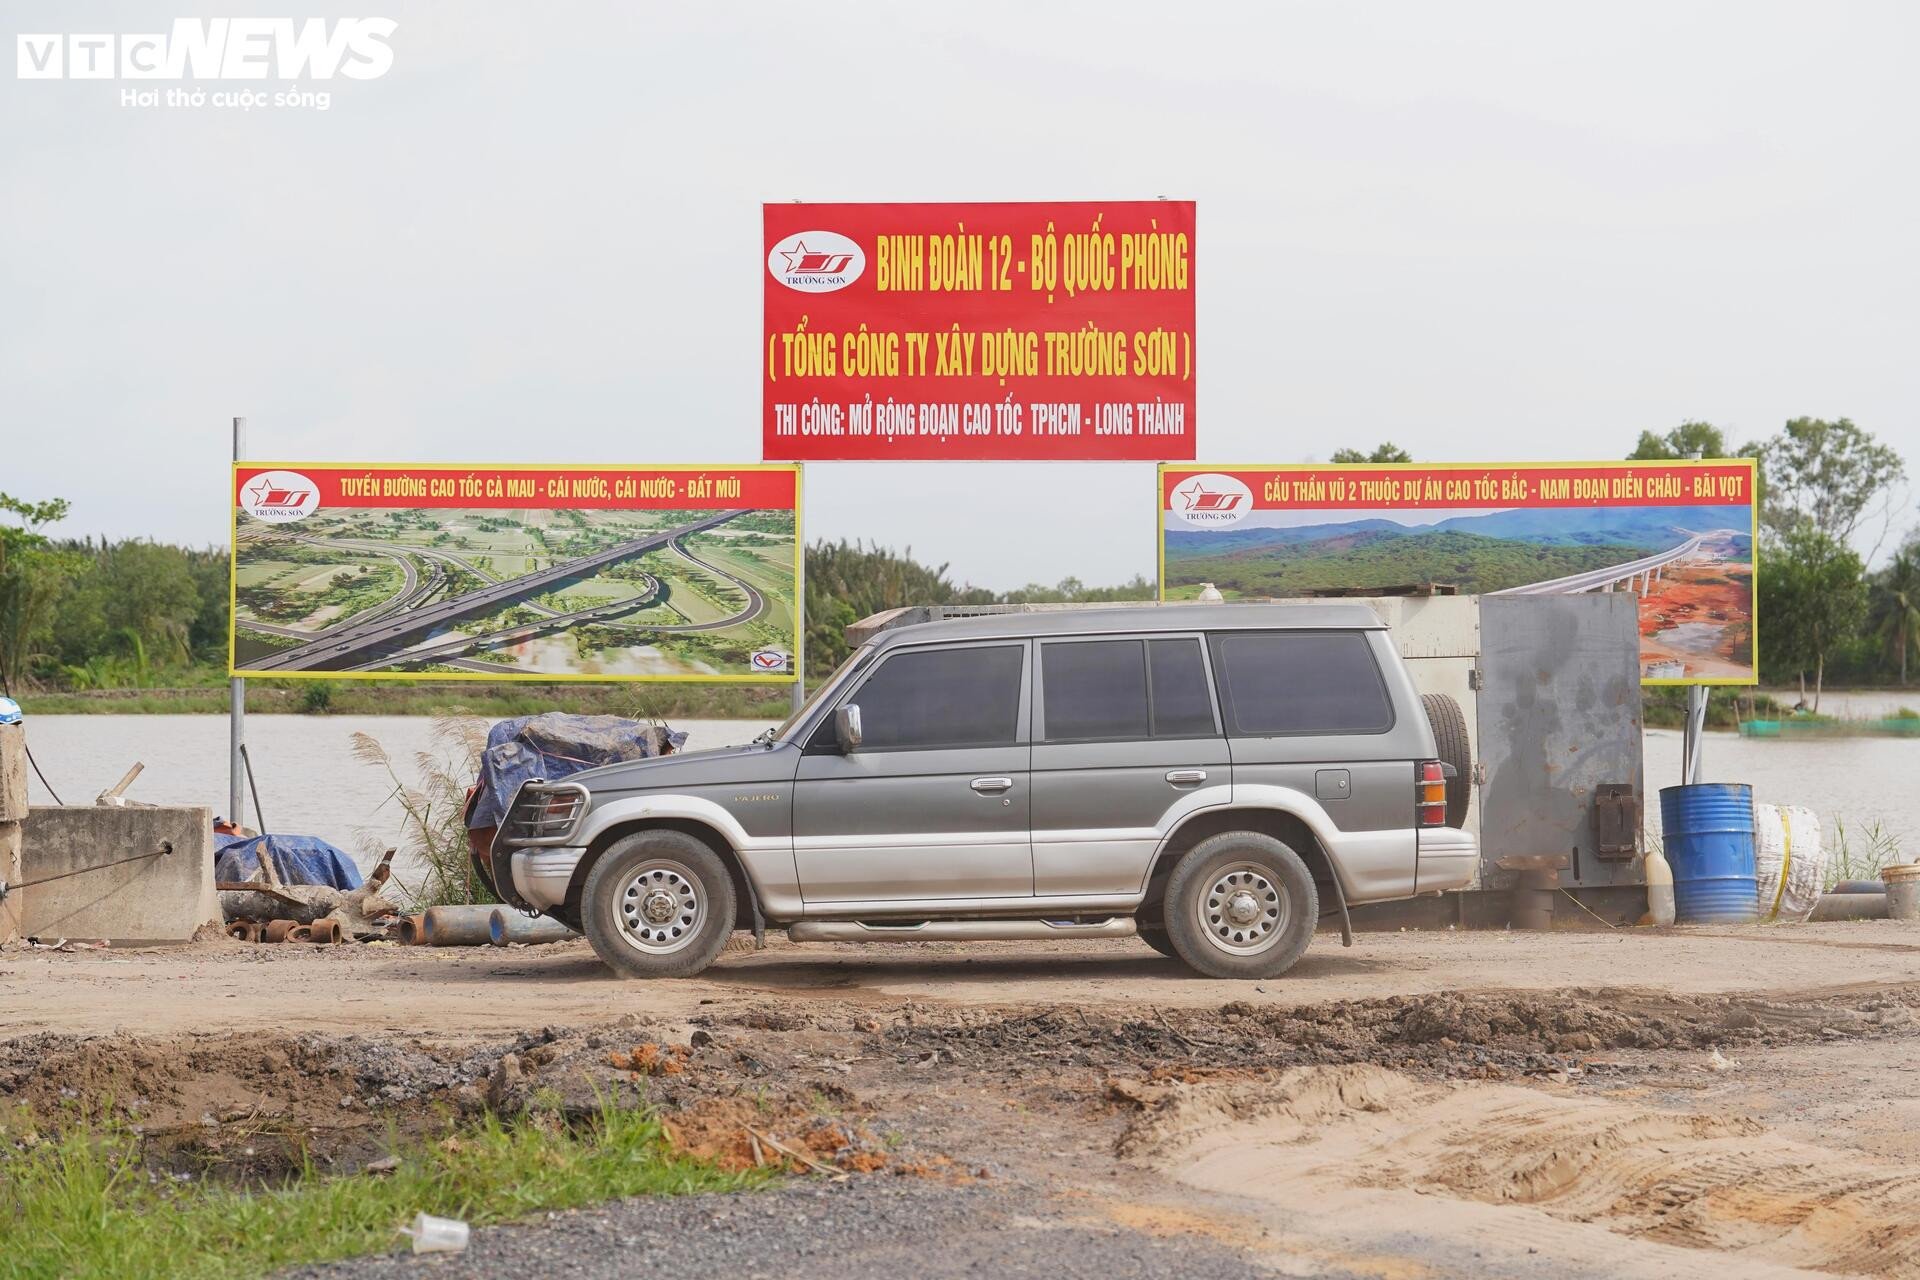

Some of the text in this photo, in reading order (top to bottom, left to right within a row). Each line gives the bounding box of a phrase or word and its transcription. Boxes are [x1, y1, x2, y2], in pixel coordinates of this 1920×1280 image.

[877, 235, 923, 291] BINH
[929, 222, 983, 291] ĐOÀN
[989, 235, 1012, 291] 12
[1031, 221, 1057, 304] BỘ
[1063, 213, 1115, 297] QUỐC
[1121, 219, 1188, 291] PHÒNG
[782, 315, 836, 377] TỔNG
[843, 323, 899, 377] CÔNG
[905, 332, 930, 377] TY
[935, 323, 976, 377] XÂY
[982, 327, 1039, 386] DỰNG
[1044, 321, 1127, 376] TRƯỜNG
[1133, 327, 1177, 376] SƠN
[775, 403, 797, 435] THI
[801, 397, 845, 436] CÔNG:
[849, 393, 873, 435] MỞ
[876, 397, 915, 442] RỘNG
[919, 403, 959, 442] ĐOẠN
[963, 403, 991, 435] CAO
[995, 392, 1022, 435] TỐC
[1031, 403, 1081, 435] TPHCM
[1095, 403, 1133, 435] LONG
[1137, 396, 1185, 435] THÀNH
[341, 473, 380, 496] TUYẾN
[383, 474, 427, 497] ĐƯỜNG
[430, 479, 455, 497] CAO
[459, 473, 482, 497] TỐC
[486, 476, 503, 497] CÀ
[507, 479, 535, 498] MAU
[547, 476, 568, 498] CÁI
[572, 475, 611, 501] NƯỚC,
[615, 476, 636, 498] CÁI
[640, 476, 675, 498] NƯỚC
[688, 474, 712, 498] ĐẤT
[716, 476, 741, 498] MŨI
[1264, 474, 1289, 502] CẦU
[1293, 473, 1326, 502] THẦN
[1329, 476, 1345, 501] VŨ
[1348, 481, 1357, 501] 2
[1360, 476, 1400, 505] THUỘC
[1404, 478, 1422, 505] DỰ
[1424, 476, 1442, 500] ÁN
[1446, 480, 1471, 500] CAO
[1474, 472, 1498, 500] TỐC
[1502, 472, 1528, 500] BẮC
[1540, 478, 1570, 499] NAM
[1574, 478, 1609, 503] ĐOẠN
[1612, 470, 1643, 498] DIỄN
[1646, 473, 1681, 498] CHÂU
[1694, 473, 1715, 497] BÃI
[1719, 476, 1744, 501] VỌT
